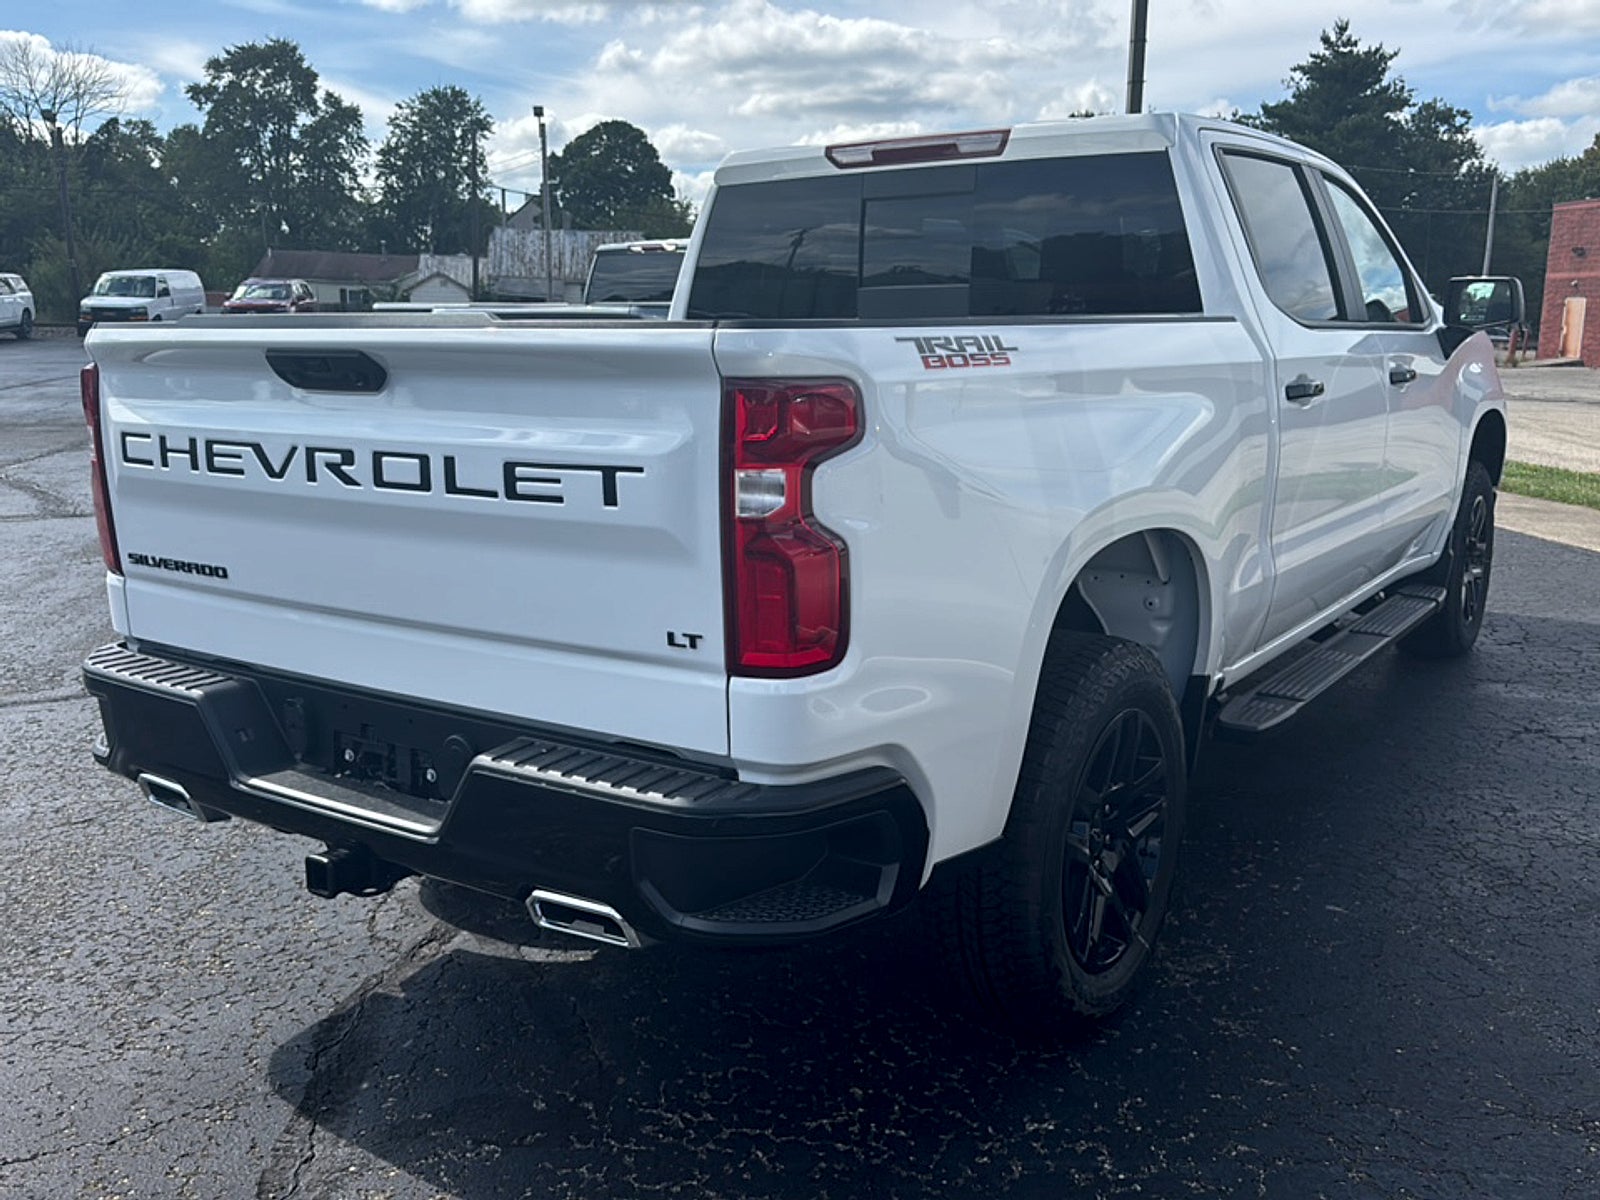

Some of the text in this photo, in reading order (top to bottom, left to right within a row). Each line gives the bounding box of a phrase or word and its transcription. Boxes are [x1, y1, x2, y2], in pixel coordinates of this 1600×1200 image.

[894, 335, 1018, 354] TRAIL
[921, 352, 1011, 369] BOSS
[121, 432, 644, 508] CHEVROLET
[128, 552, 228, 579] SILVERADO
[666, 631, 703, 650] LT
